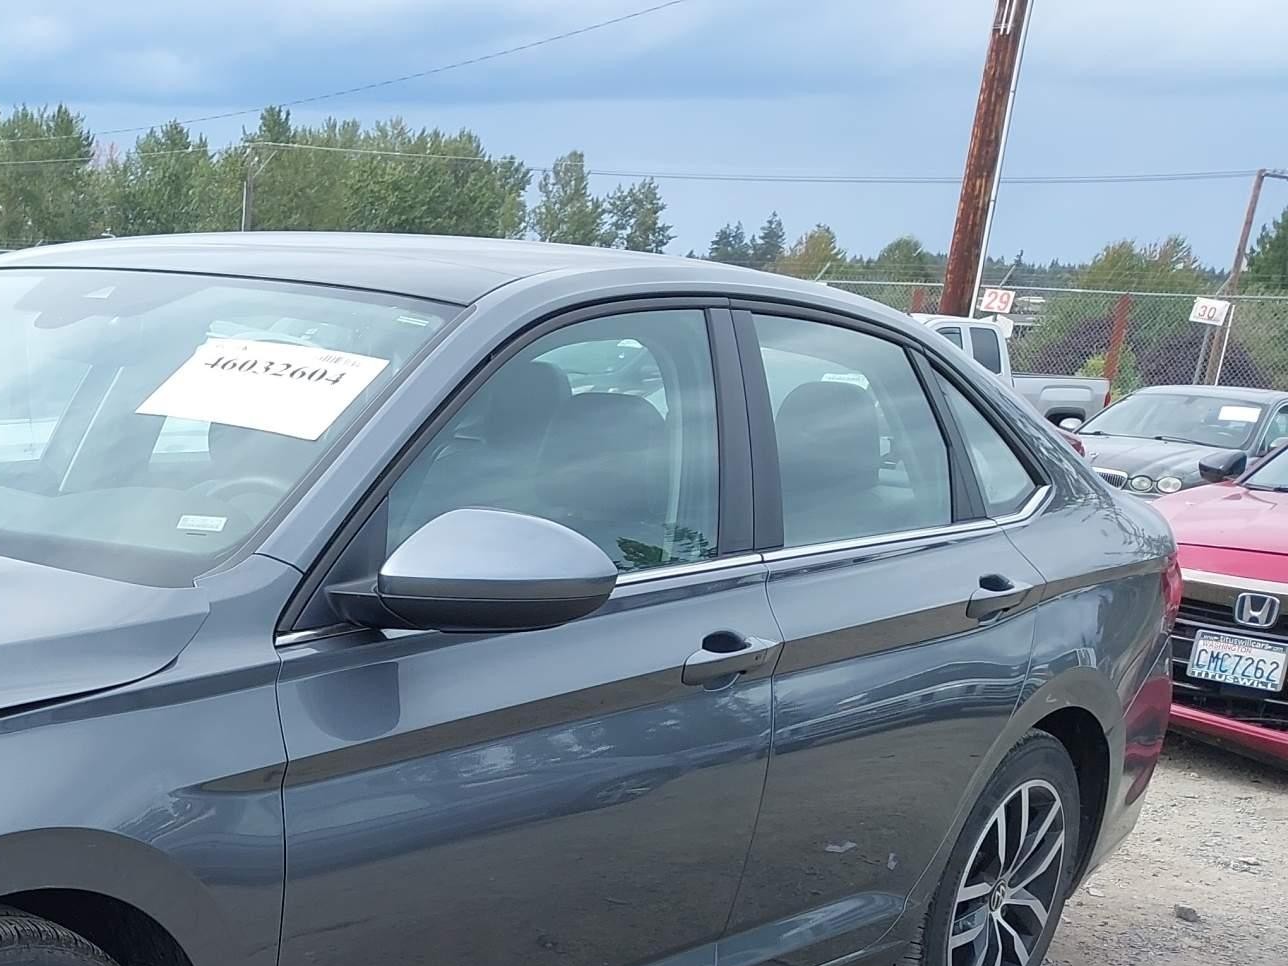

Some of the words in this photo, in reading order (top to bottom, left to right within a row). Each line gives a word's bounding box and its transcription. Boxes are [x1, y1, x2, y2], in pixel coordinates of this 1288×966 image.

[983, 291, 1011, 311] 29
[1198, 304, 1217, 319] 30
[204, 355, 347, 386] 46032604
[1196, 648, 1280, 683] CMC7262
